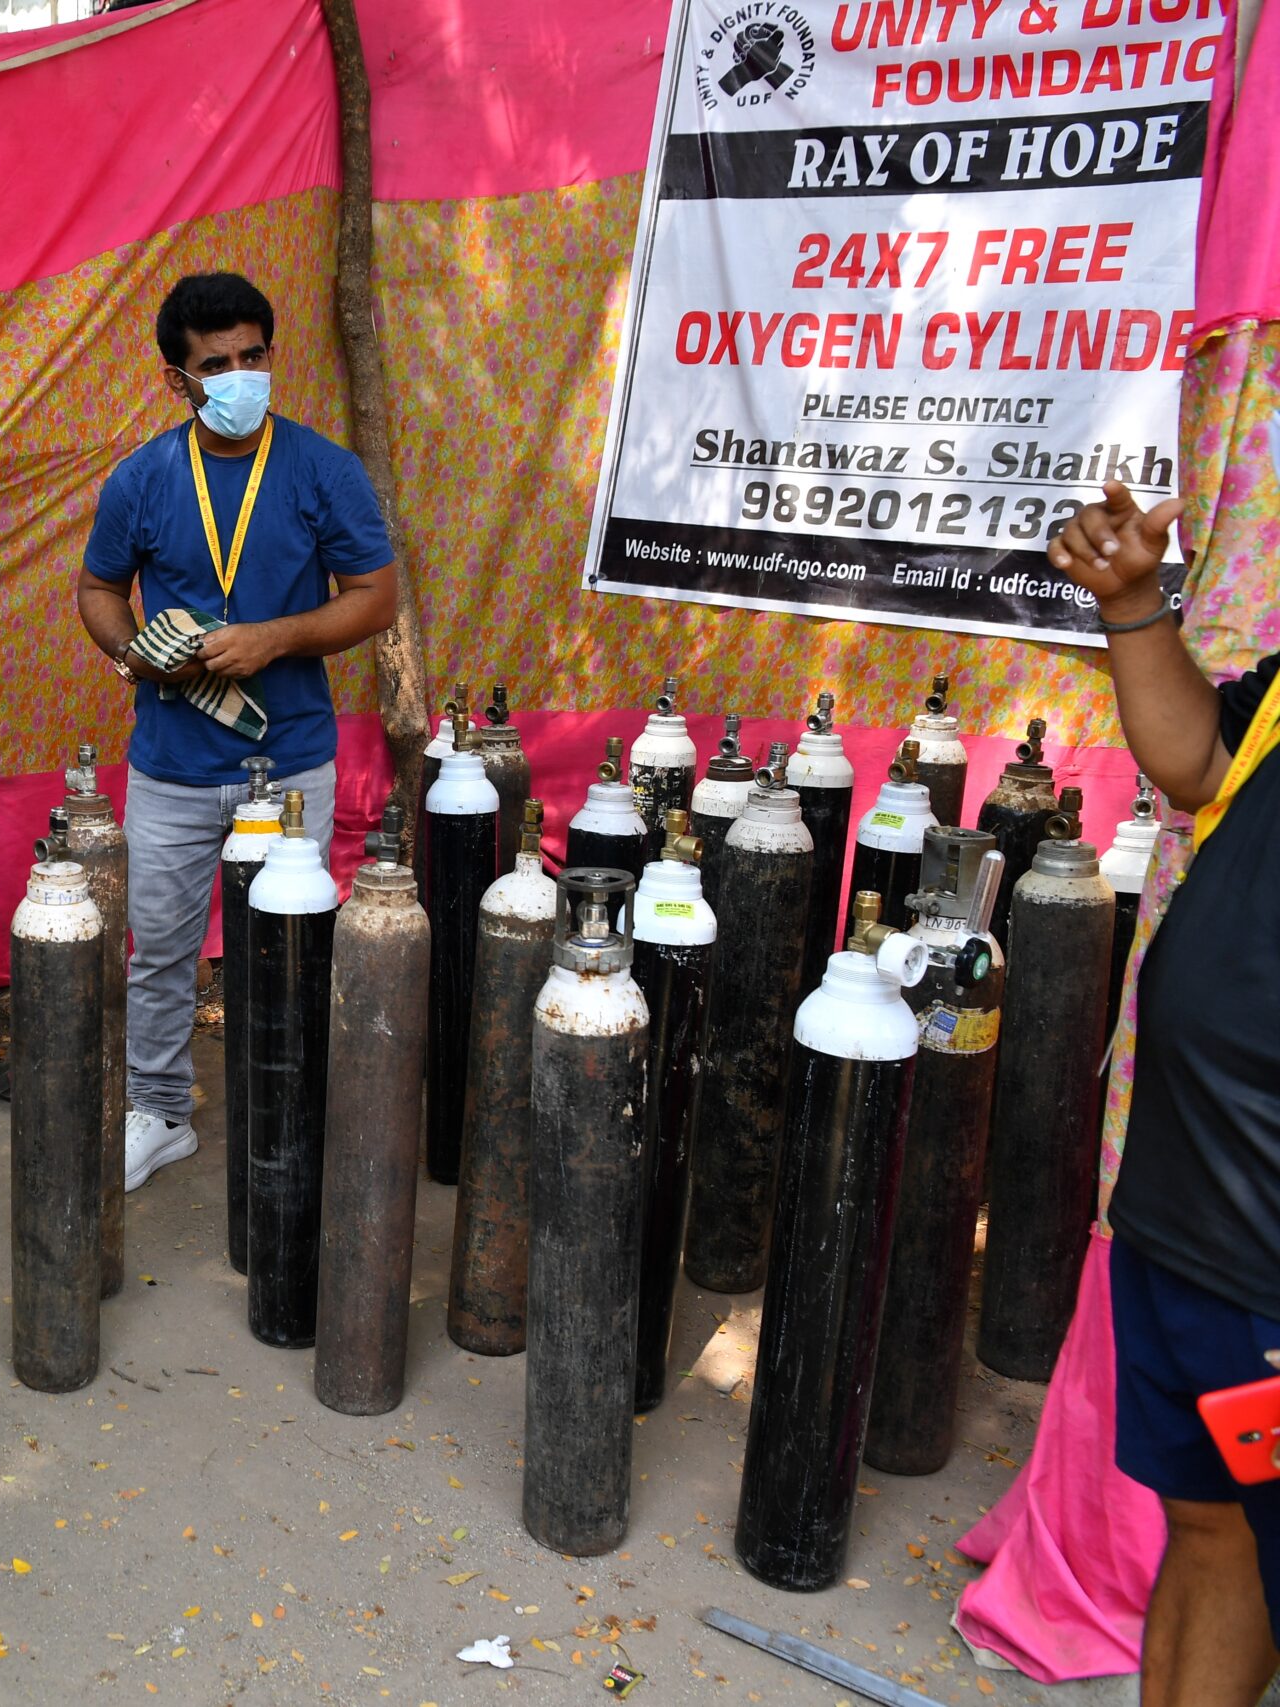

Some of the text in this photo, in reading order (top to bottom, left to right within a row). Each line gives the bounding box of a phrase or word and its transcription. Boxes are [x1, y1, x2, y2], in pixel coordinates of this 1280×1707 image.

[697, 2, 815, 110] UNITY & DIGNITY FOUNDATION
[830, 0, 995, 53] UNITY
[1018, 0, 1059, 35] &
[736, 92, 772, 107] UDF
[872, 34, 1223, 108] FOUNDATIO
[787, 114, 1180, 189] RAY OF HOPE
[792, 222, 1134, 289] 24X7 FREE
[675, 309, 1196, 371] OXYGEN CYLINDE
[803, 393, 1054, 425] PLEASE CONTACT
[692, 428, 1174, 488] Shanawaz S. Shaikh
[741, 481, 1085, 541] 9892012132
[624, 538, 691, 564] Website
[707, 551, 867, 582] www.udf-ngo.com
[892, 563, 946, 589] Email
